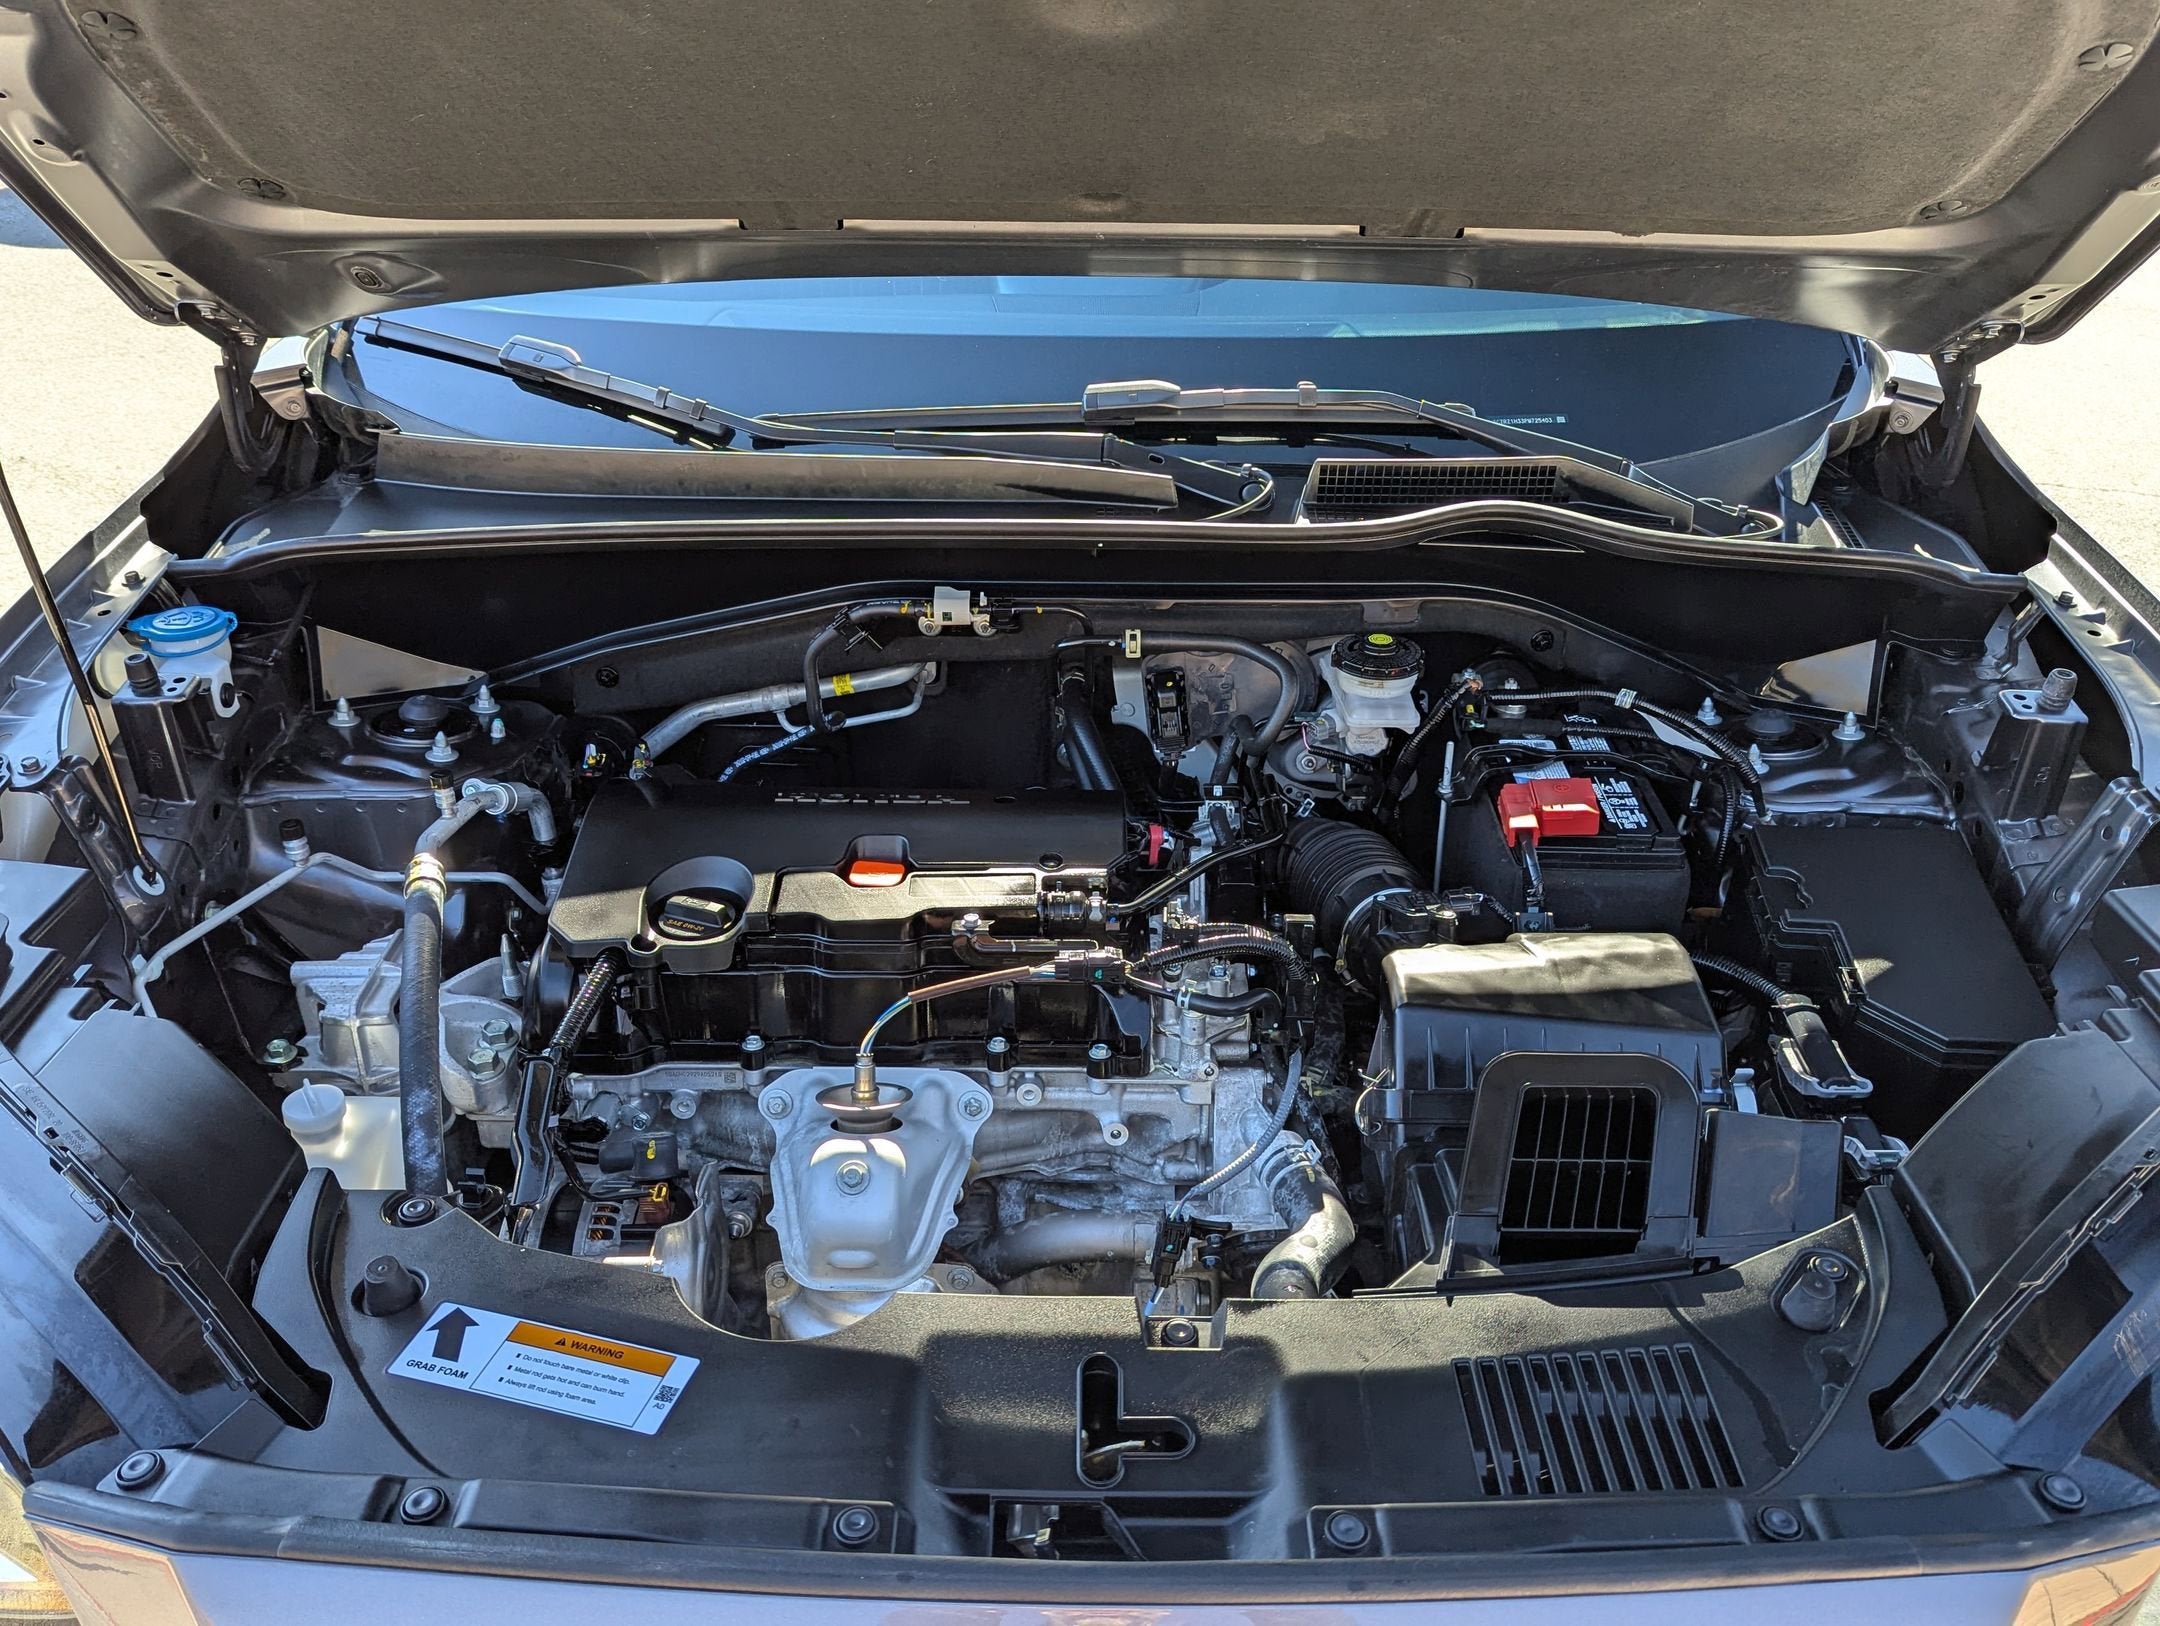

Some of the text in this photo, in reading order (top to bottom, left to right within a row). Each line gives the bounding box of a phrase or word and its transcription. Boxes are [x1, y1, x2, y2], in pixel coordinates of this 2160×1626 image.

[666, 919, 681, 927] SAE
[570, 1340, 625, 1360] WARNING
[406, 1359, 469, 1380] GRAB FOAM
[543, 1359, 561, 1367] touch
[560, 1363, 575, 1371] bare
[575, 1367, 593, 1376] metal
[601, 1373, 618, 1382] white
[505, 1378, 528, 1389] Always
[547, 1389, 565, 1398] using
[564, 1392, 581, 1401] foam
[581, 1397, 596, 1405] area.
[513, 1366, 532, 1375] Metal
[556, 1376, 568, 1384] hot
[567, 1379, 581, 1387] and
[592, 1385, 607, 1393] burn
[608, 1388, 626, 1397] hand.
